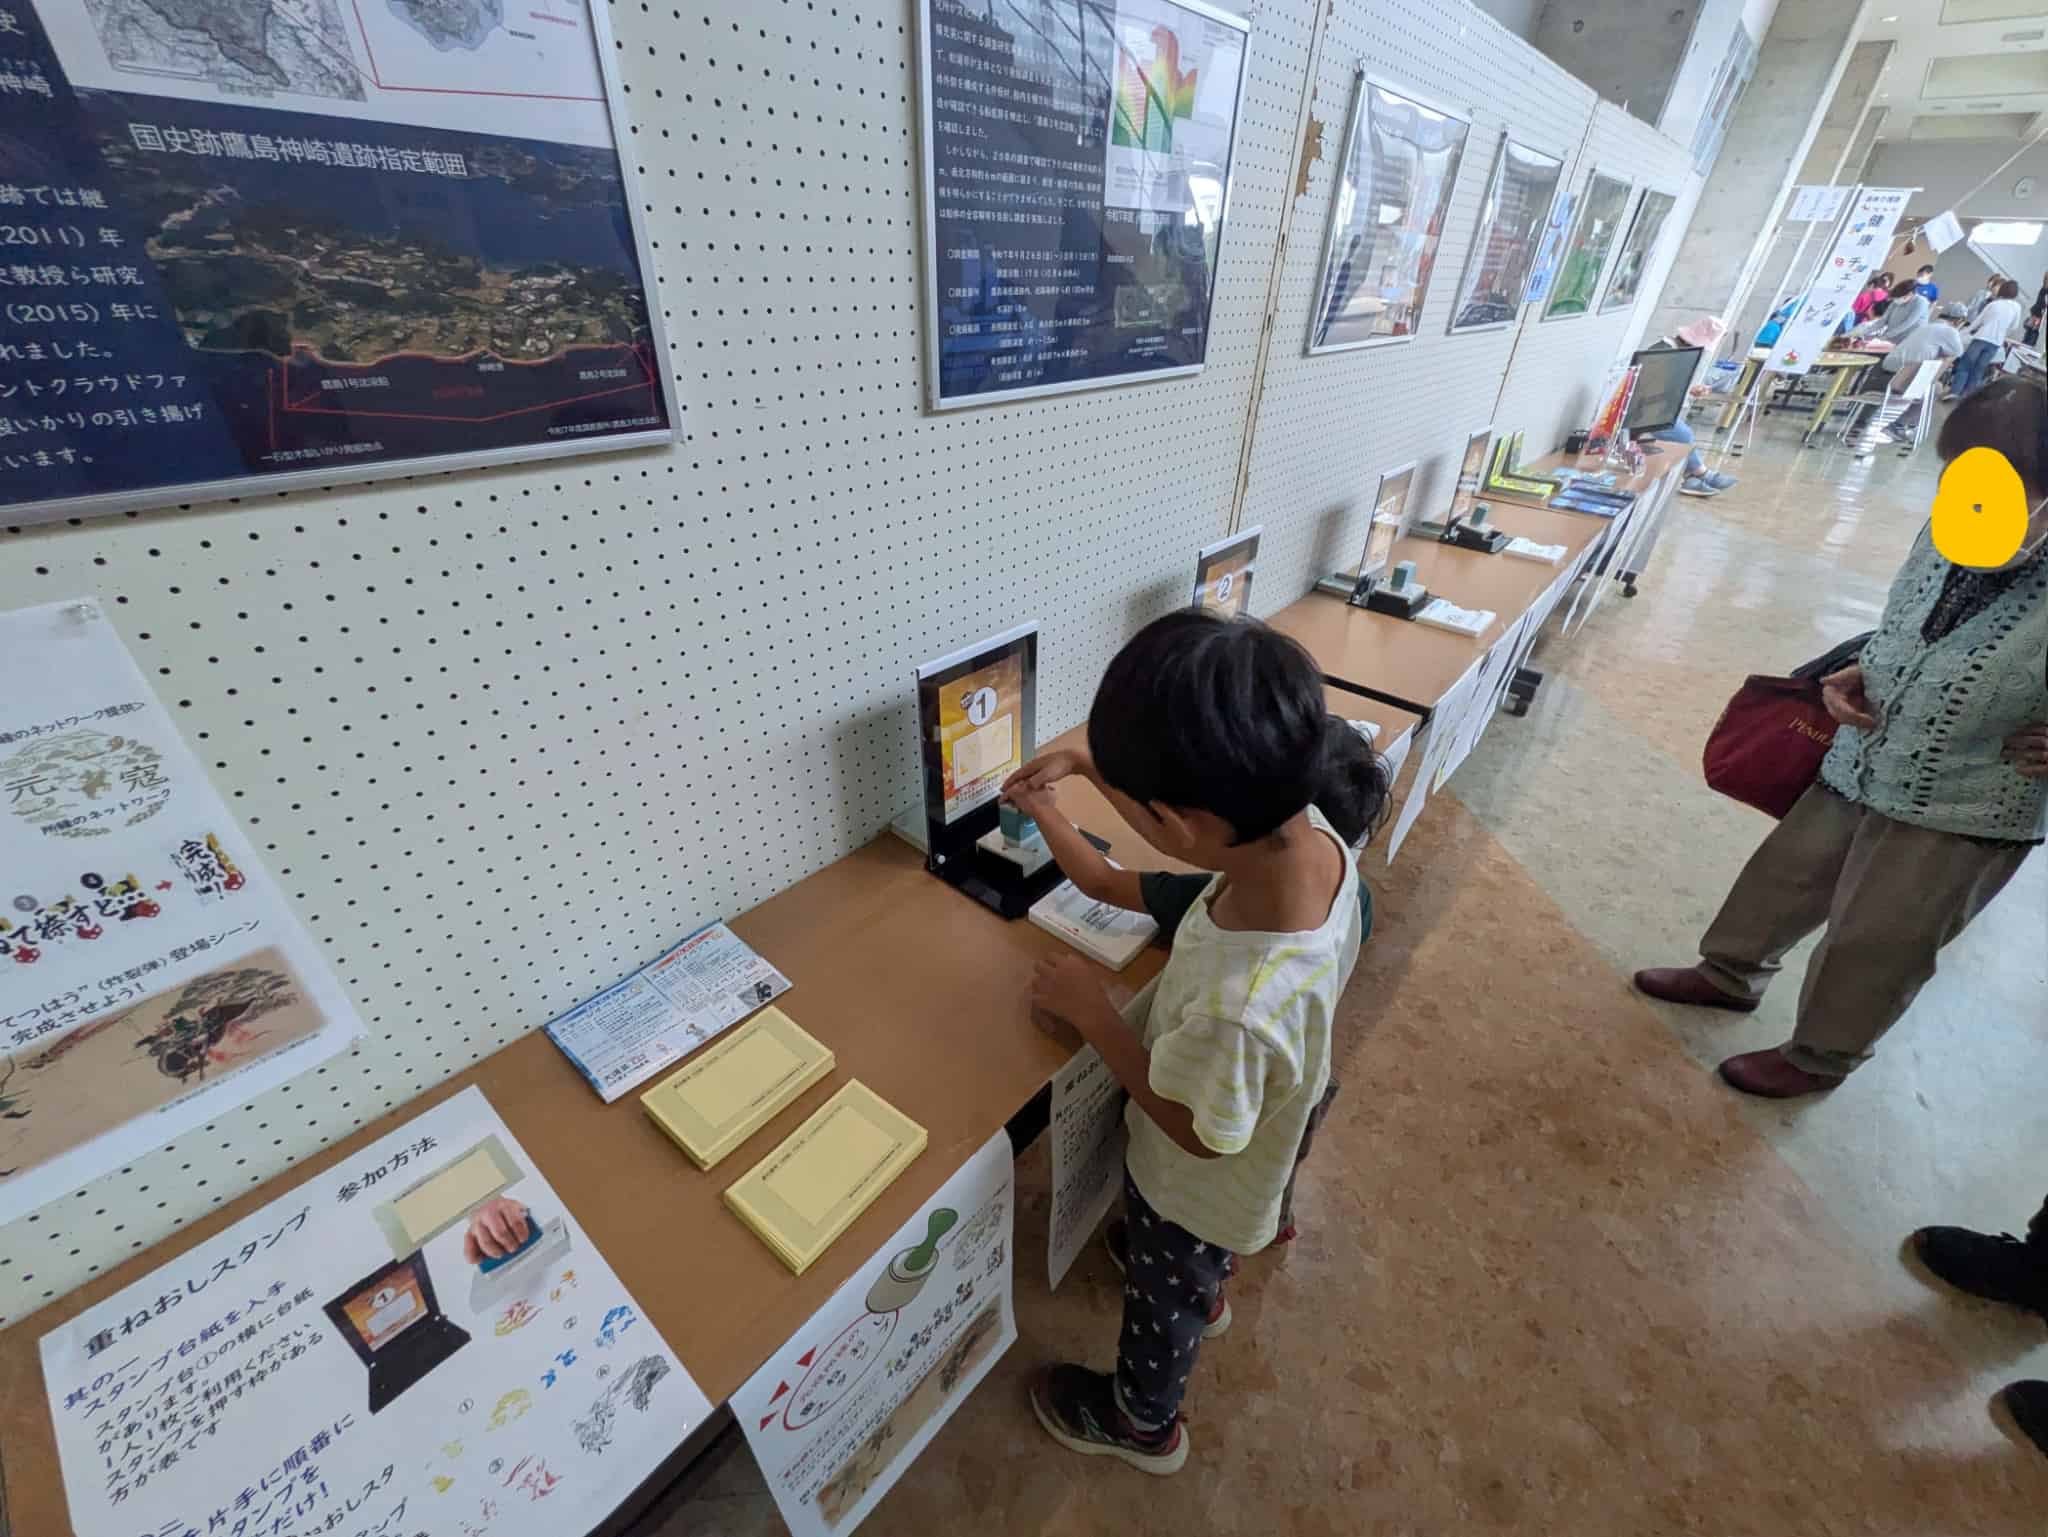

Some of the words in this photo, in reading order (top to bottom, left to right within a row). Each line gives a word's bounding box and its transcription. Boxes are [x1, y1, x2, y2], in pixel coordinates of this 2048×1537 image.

[84, 1205, 312, 1360] 重ねおしスタンプ
[336, 1136, 438, 1202] 参加方法
[83, 1280, 287, 1420] スタンプ台紙を入手
